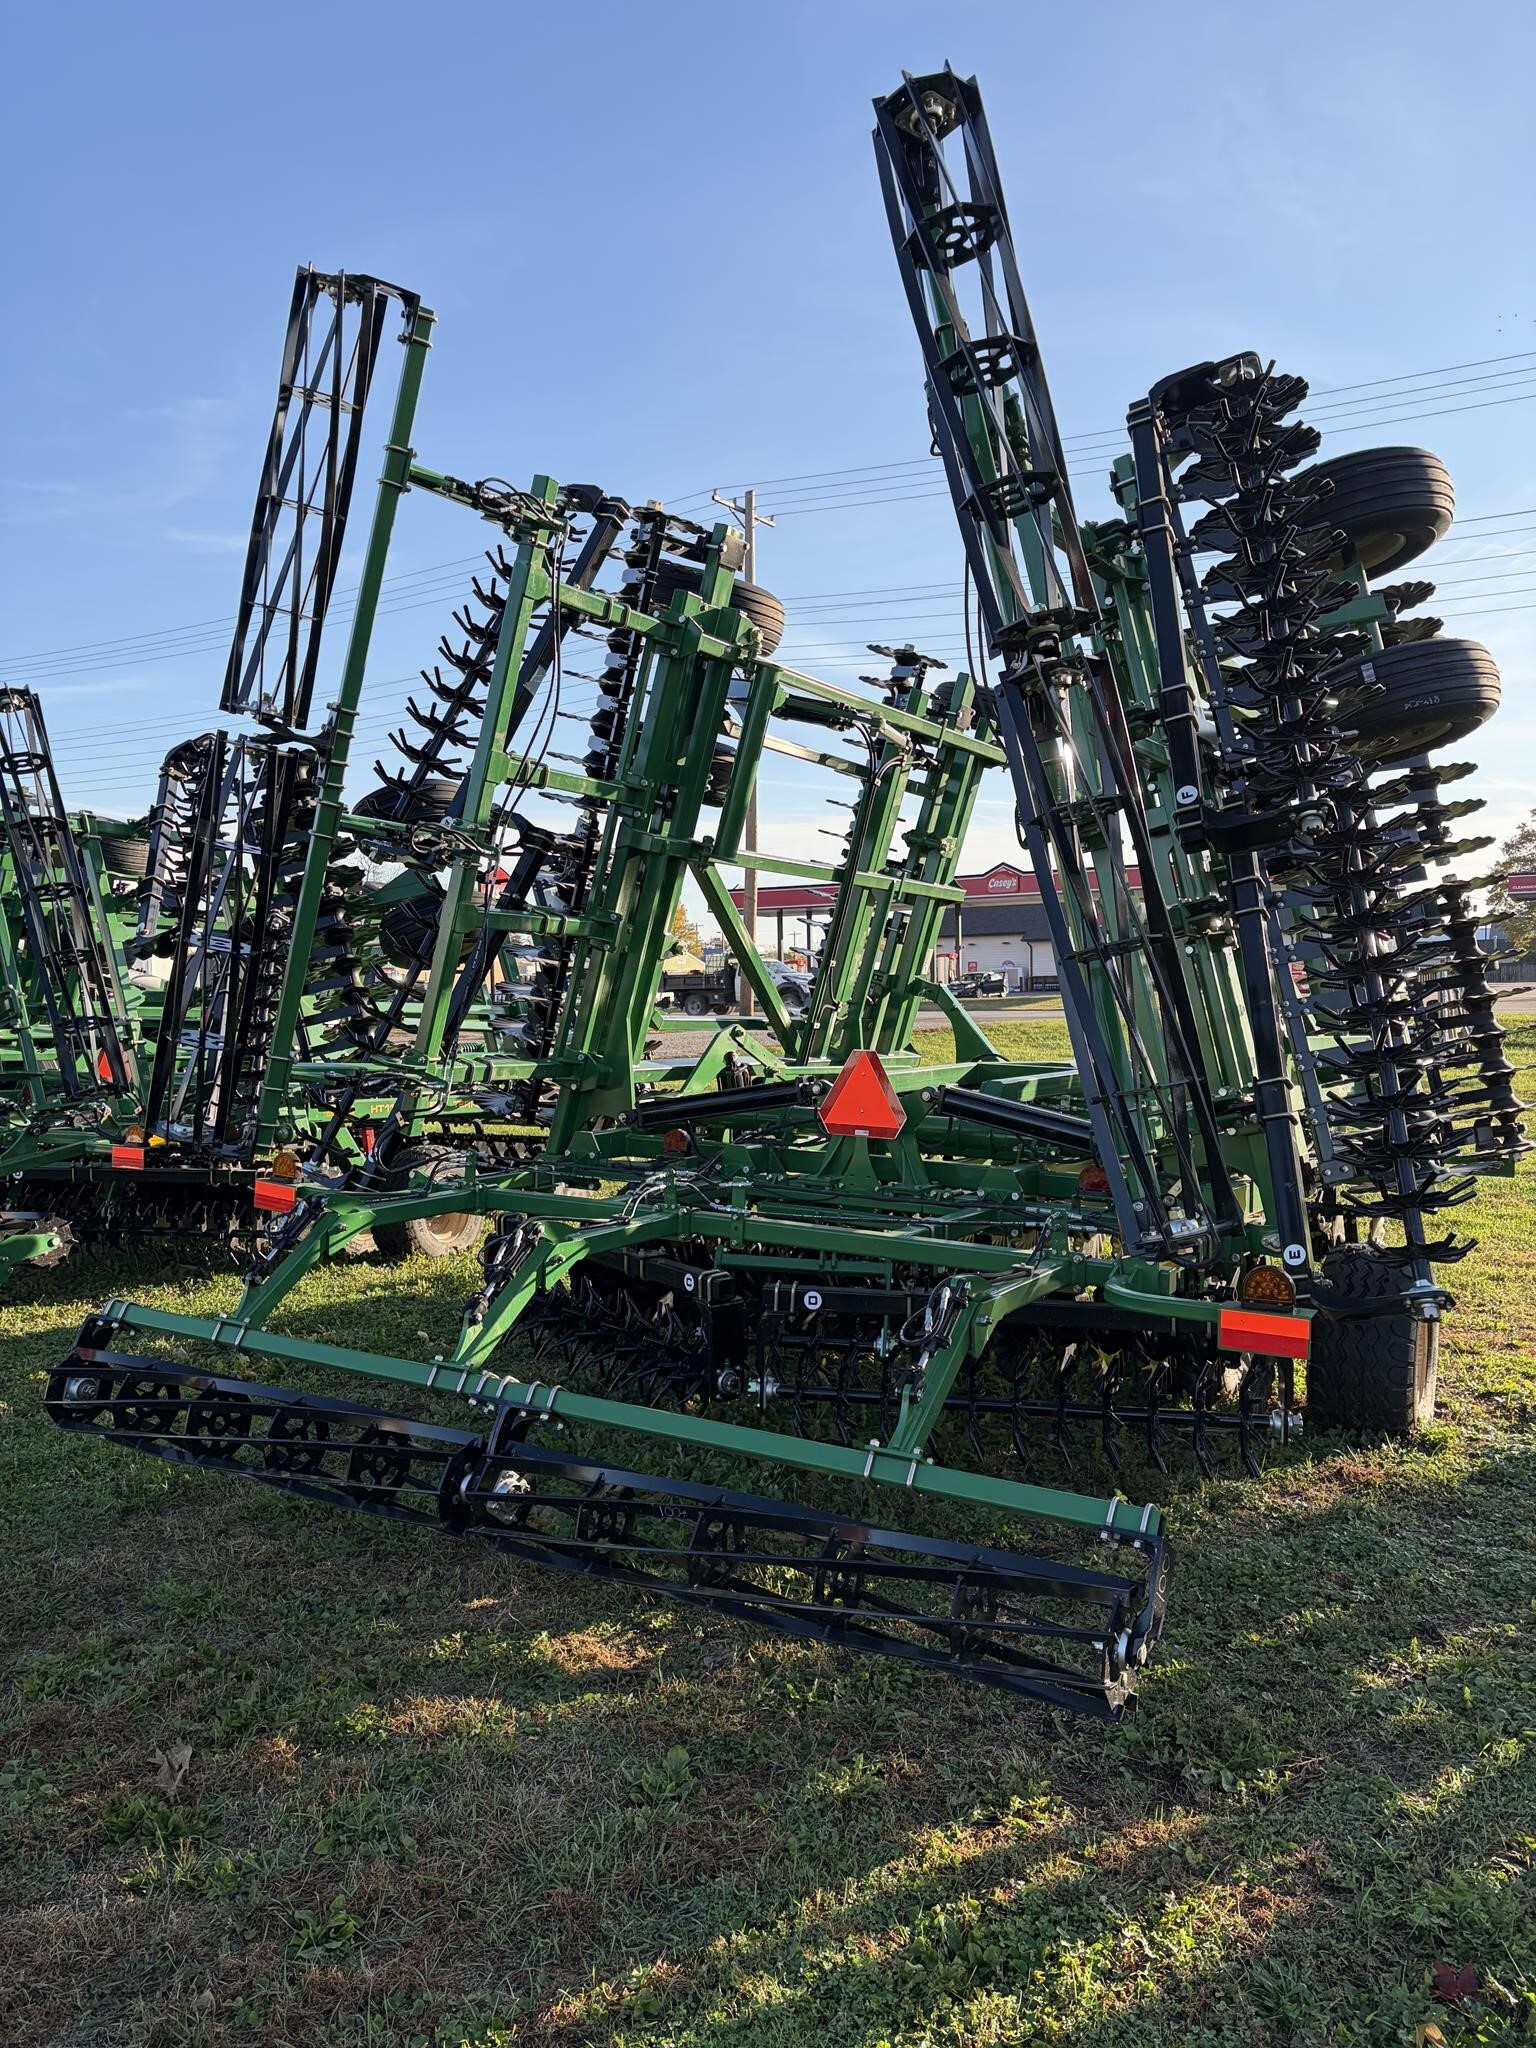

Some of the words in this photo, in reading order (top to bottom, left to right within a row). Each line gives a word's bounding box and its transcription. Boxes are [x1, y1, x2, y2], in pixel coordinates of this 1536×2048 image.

[1181, 790, 1194, 800] F
[988, 877, 1017, 889] Casey's
[1288, 1249, 1301, 1260] E
